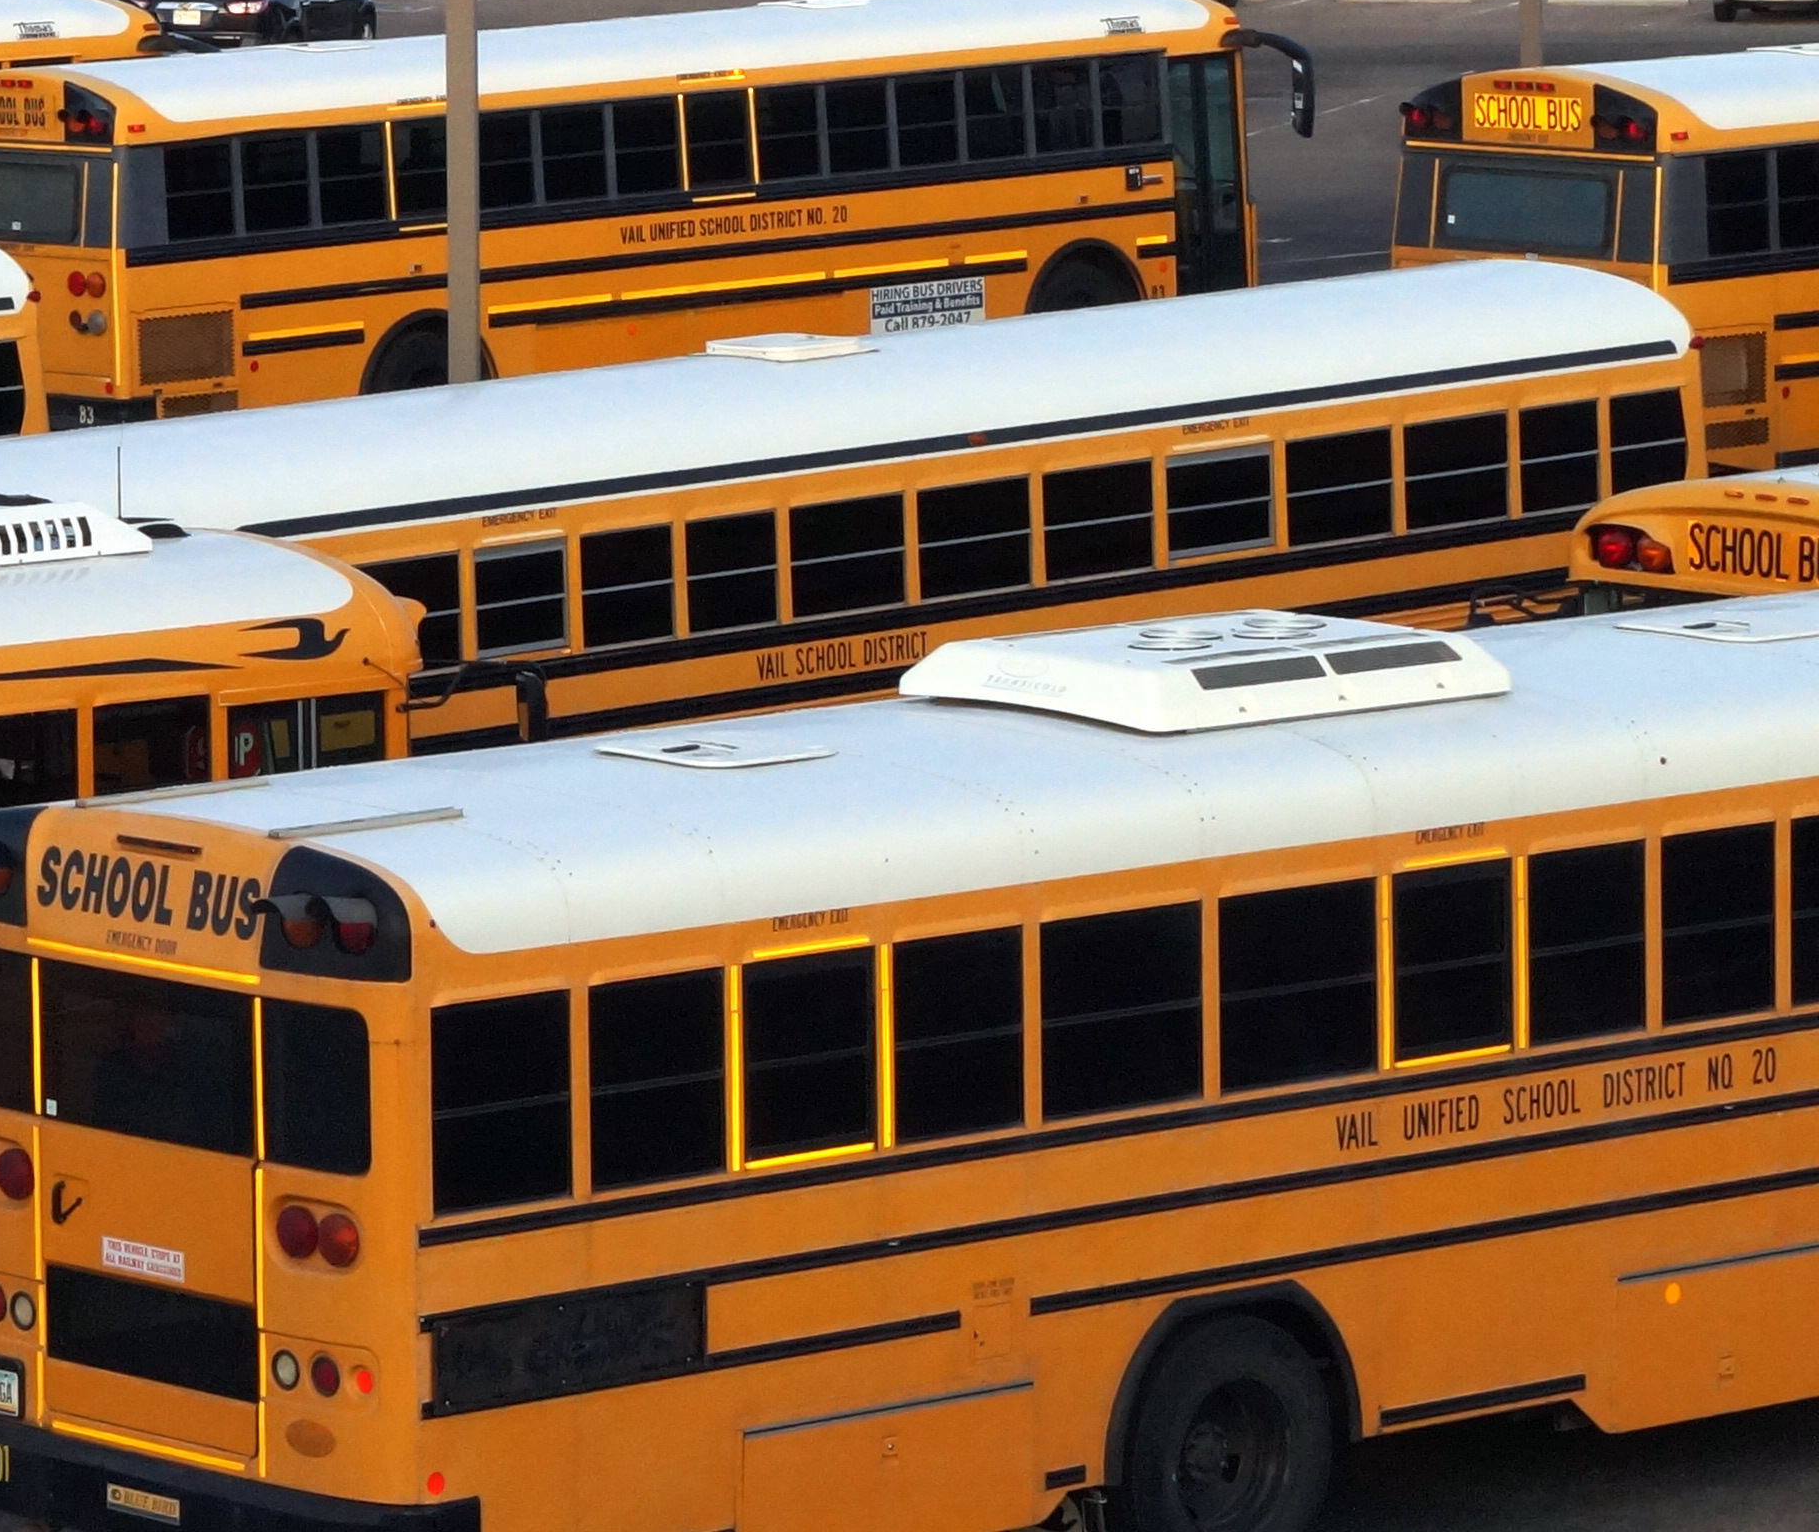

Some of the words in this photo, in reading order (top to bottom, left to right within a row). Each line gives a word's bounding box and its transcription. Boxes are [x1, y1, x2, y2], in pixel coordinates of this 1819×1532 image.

[24, 96, 45, 127] BUS
[1475, 94, 1542, 130] SCHOOL
[1547, 99, 1581, 131] BUS
[620, 226, 646, 244] VAIL
[649, 219, 695, 241] UNIFIED
[699, 215, 746, 237] SCHOOL
[749, 208, 806, 232] DISTRICT
[806, 208, 827, 226] NO.
[833, 205, 847, 224] 20
[871, 286, 910, 302] HIRING
[912, 283, 935, 297] BUS
[937, 279, 983, 296] DRIVERS
[874, 302, 895, 315] Paid
[896, 299, 933, 314] Training
[935, 298, 942, 309] &
[943, 295, 980, 309] Benefits
[885, 317, 909, 333] Call
[912, 311, 972, 329] 879-2047
[79, 404, 94, 424] 83
[482, 511, 534, 528] EMERGENCY
[538, 507, 558, 521] EXIT
[1688, 523, 1790, 580] SCHOOL
[1798, 535, 1819, 582] B
[756, 650, 789, 682] VAIL
[795, 641, 857, 675] SCHOOL
[863, 631, 929, 668] DISTRICT
[1467, 821, 1486, 838] EXIT
[36, 845, 173, 926] SCHOOL
[185, 869, 262, 941] BUS
[772, 912, 826, 933] EMERGENCY
[829, 907, 849, 925] EXIT
[106, 929, 153, 952] EMERGENCY
[1335, 1111, 1379, 1152] VAIL
[1403, 1094, 1480, 1142] UNIFIED
[1503, 1078, 1581, 1126] SCHOOL
[1603, 1061, 1686, 1109] DISTRICT
[1752, 1046, 1777, 1085] 20
